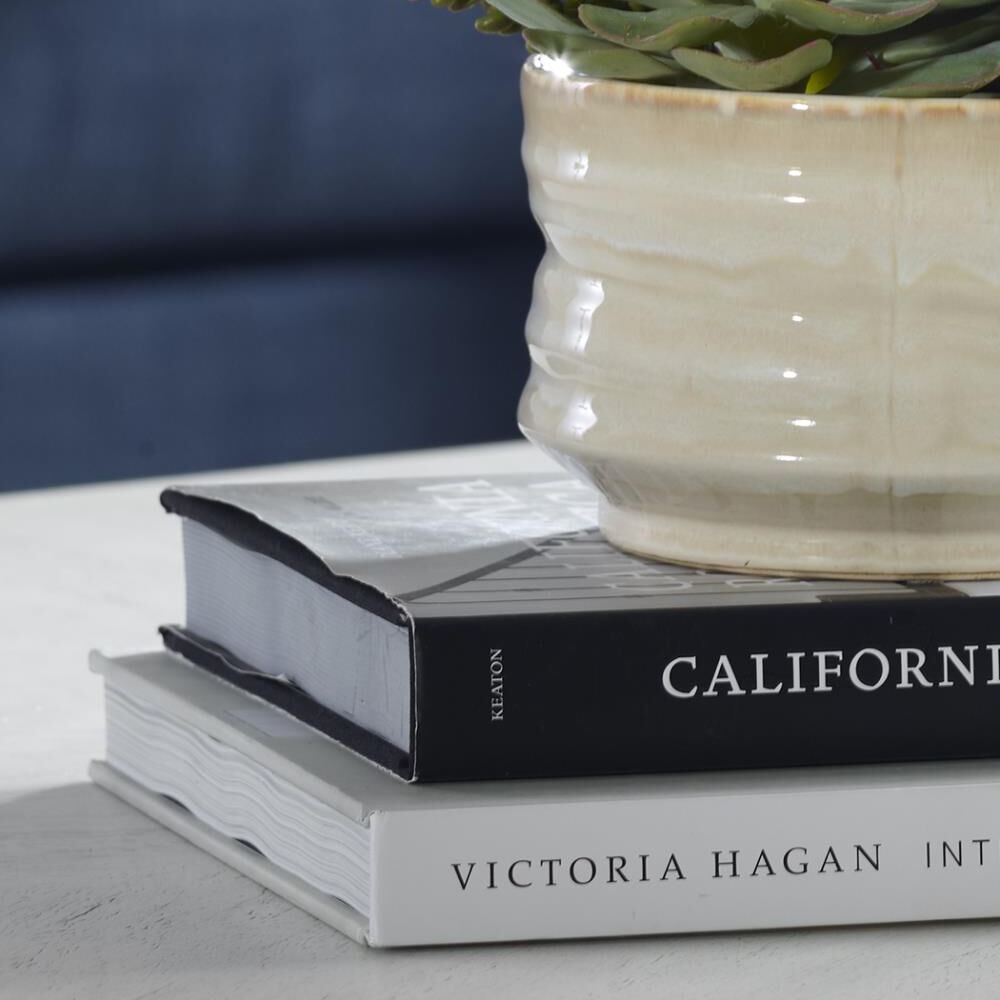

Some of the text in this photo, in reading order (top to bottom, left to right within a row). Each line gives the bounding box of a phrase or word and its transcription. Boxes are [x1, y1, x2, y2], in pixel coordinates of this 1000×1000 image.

[489, 648, 505, 722] KEATON
[449, 851, 688, 892] VICTORIA
[710, 842, 883, 880] HAGAN
